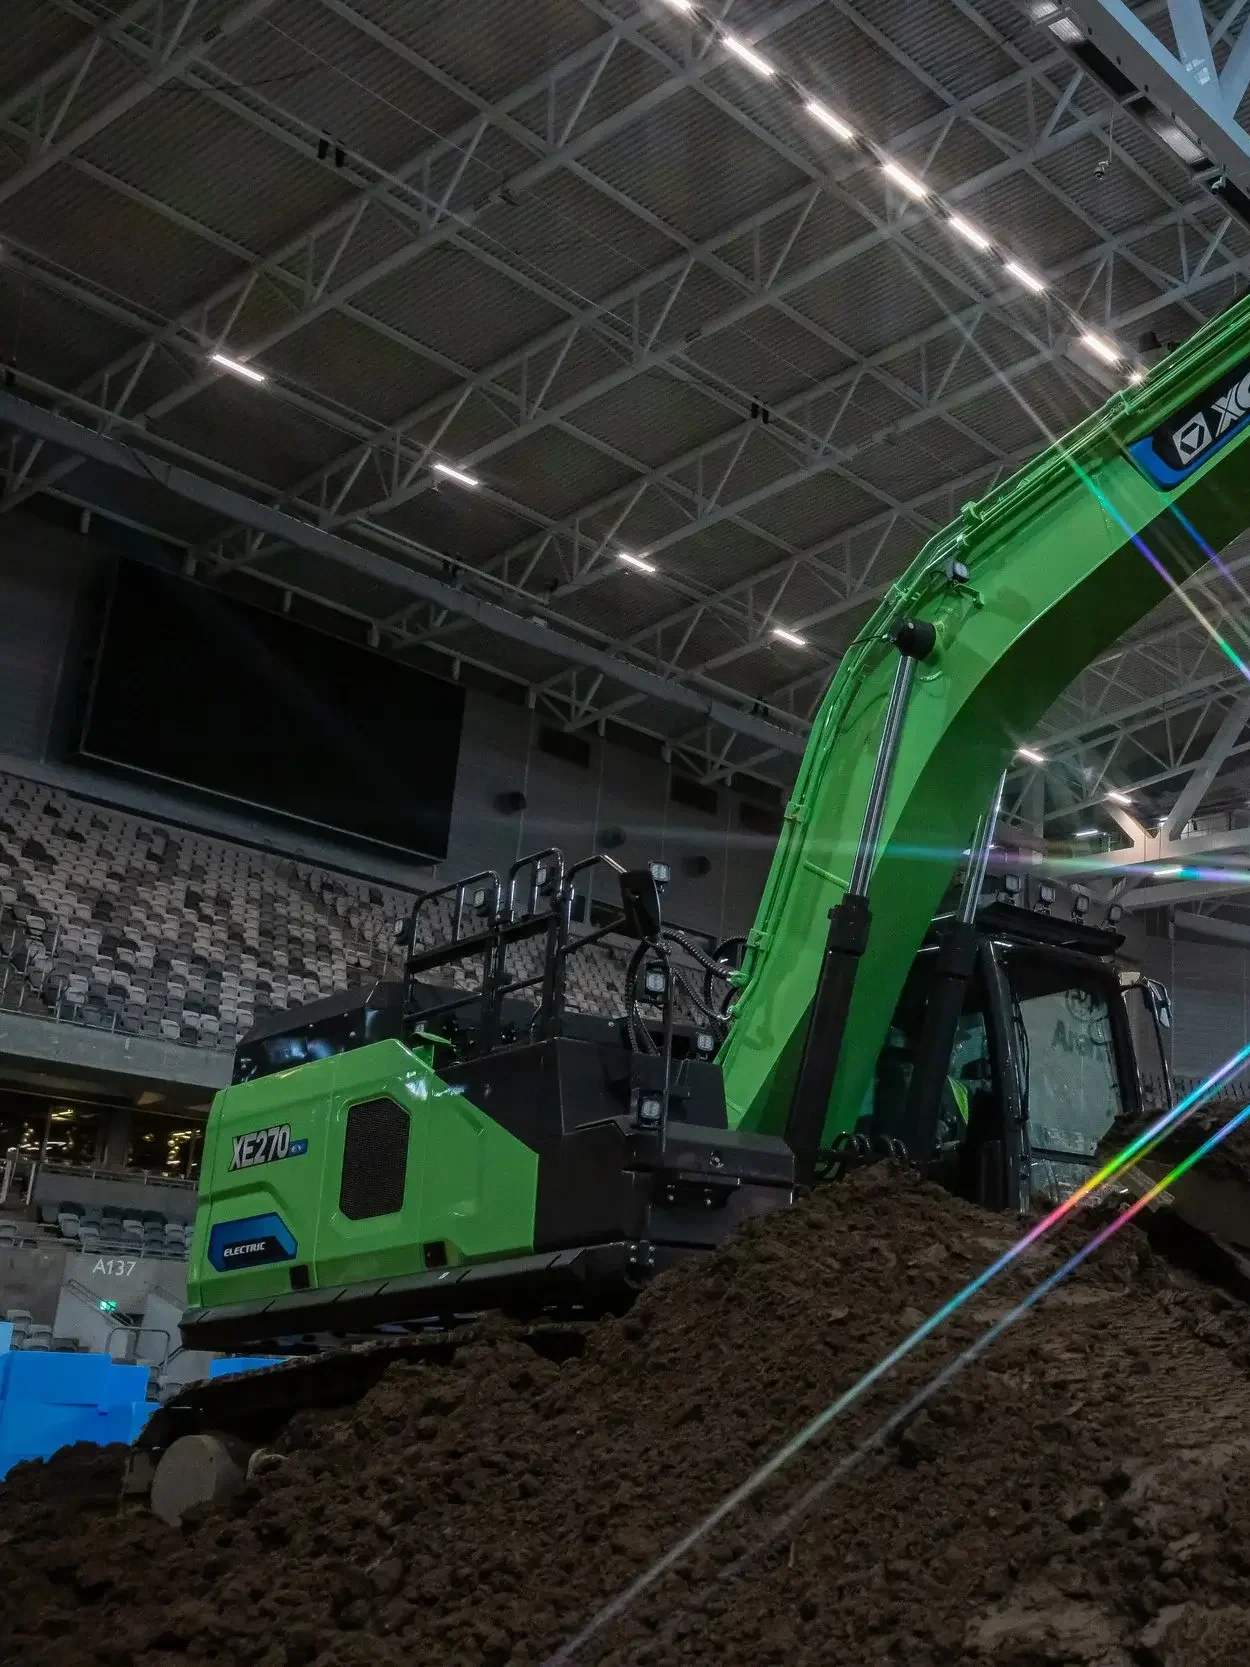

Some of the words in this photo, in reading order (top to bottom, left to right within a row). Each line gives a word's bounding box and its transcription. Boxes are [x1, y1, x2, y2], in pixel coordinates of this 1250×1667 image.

[228, 1124, 291, 1171] XE270
[223, 1241, 266, 1257] ELECTRIC
[92, 1258, 137, 1276] A137
